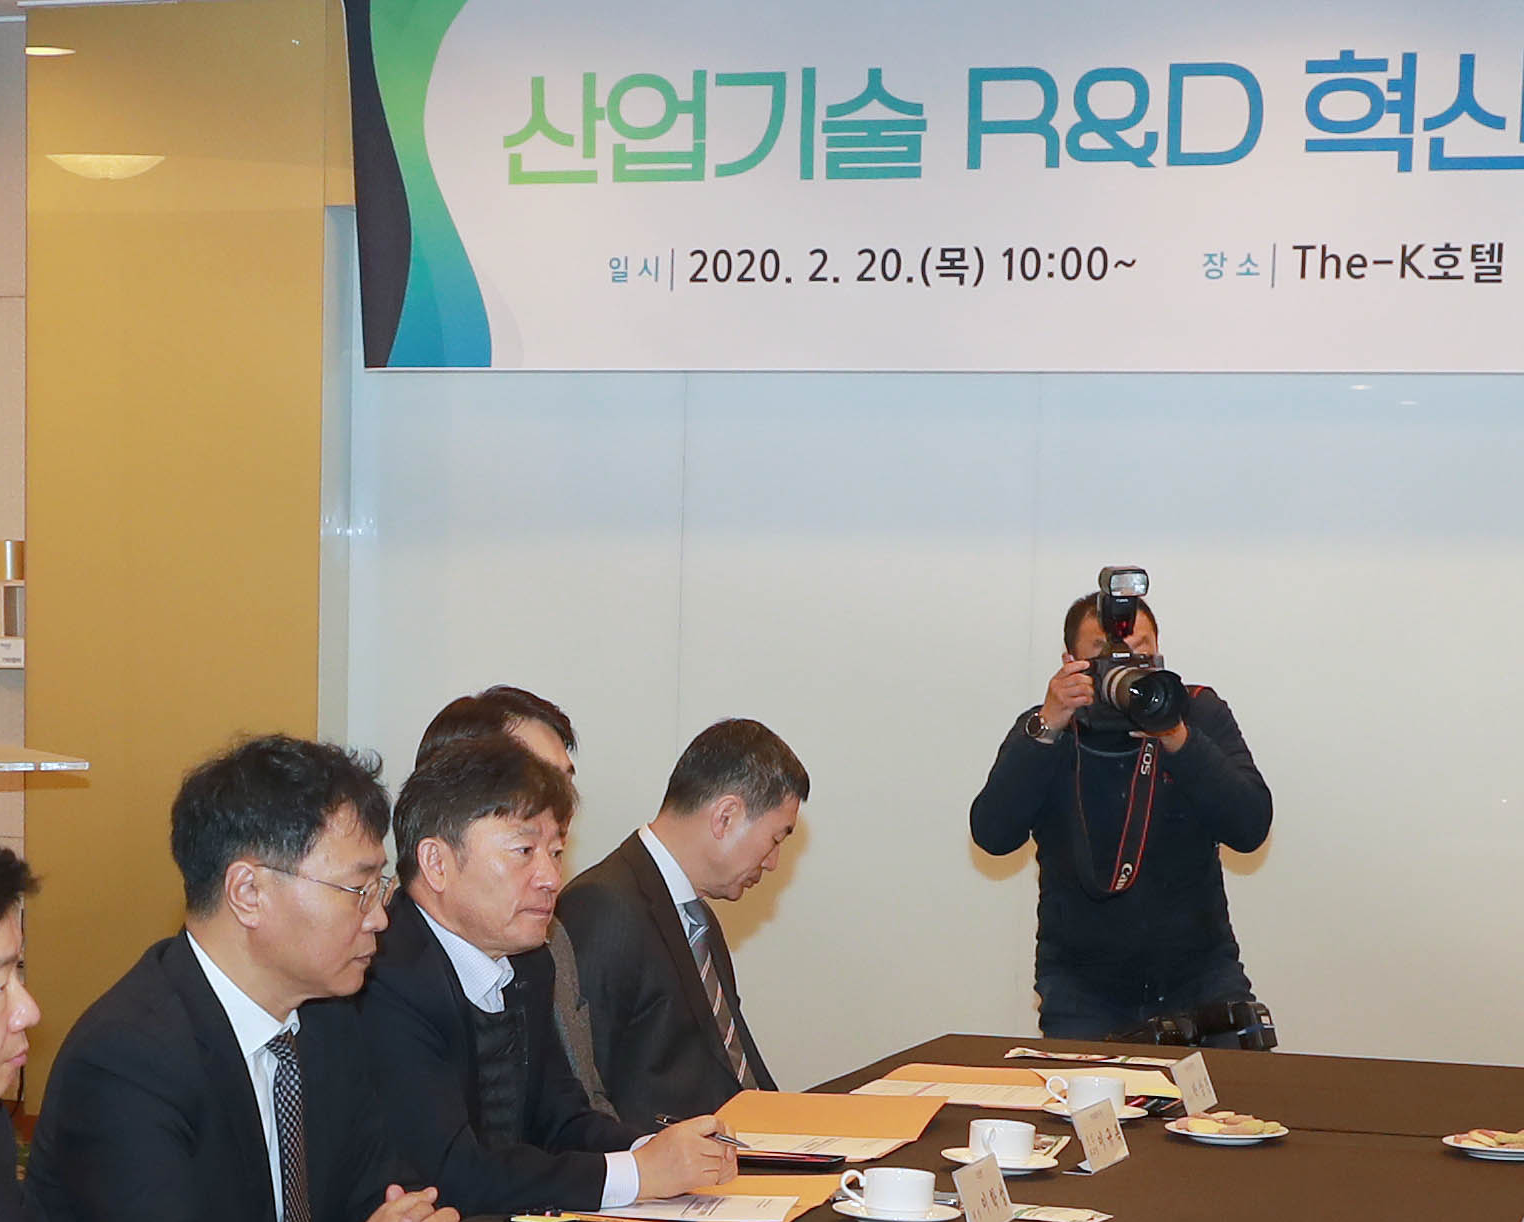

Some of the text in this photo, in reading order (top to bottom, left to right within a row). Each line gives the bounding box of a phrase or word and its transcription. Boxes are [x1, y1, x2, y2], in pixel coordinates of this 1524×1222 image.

[502, 65, 929, 185] 산업기술
[966, 58, 1266, 171] R&D
[688, 248, 793, 285] 2020.
[807, 248, 841, 284] 2.
[855, 245, 986, 289] 20.(목)
[1001, 246, 1138, 283] 10:00~
[1291, 241, 1505, 285] The-K호텔
[1140, 742, 1154, 776] EOS
